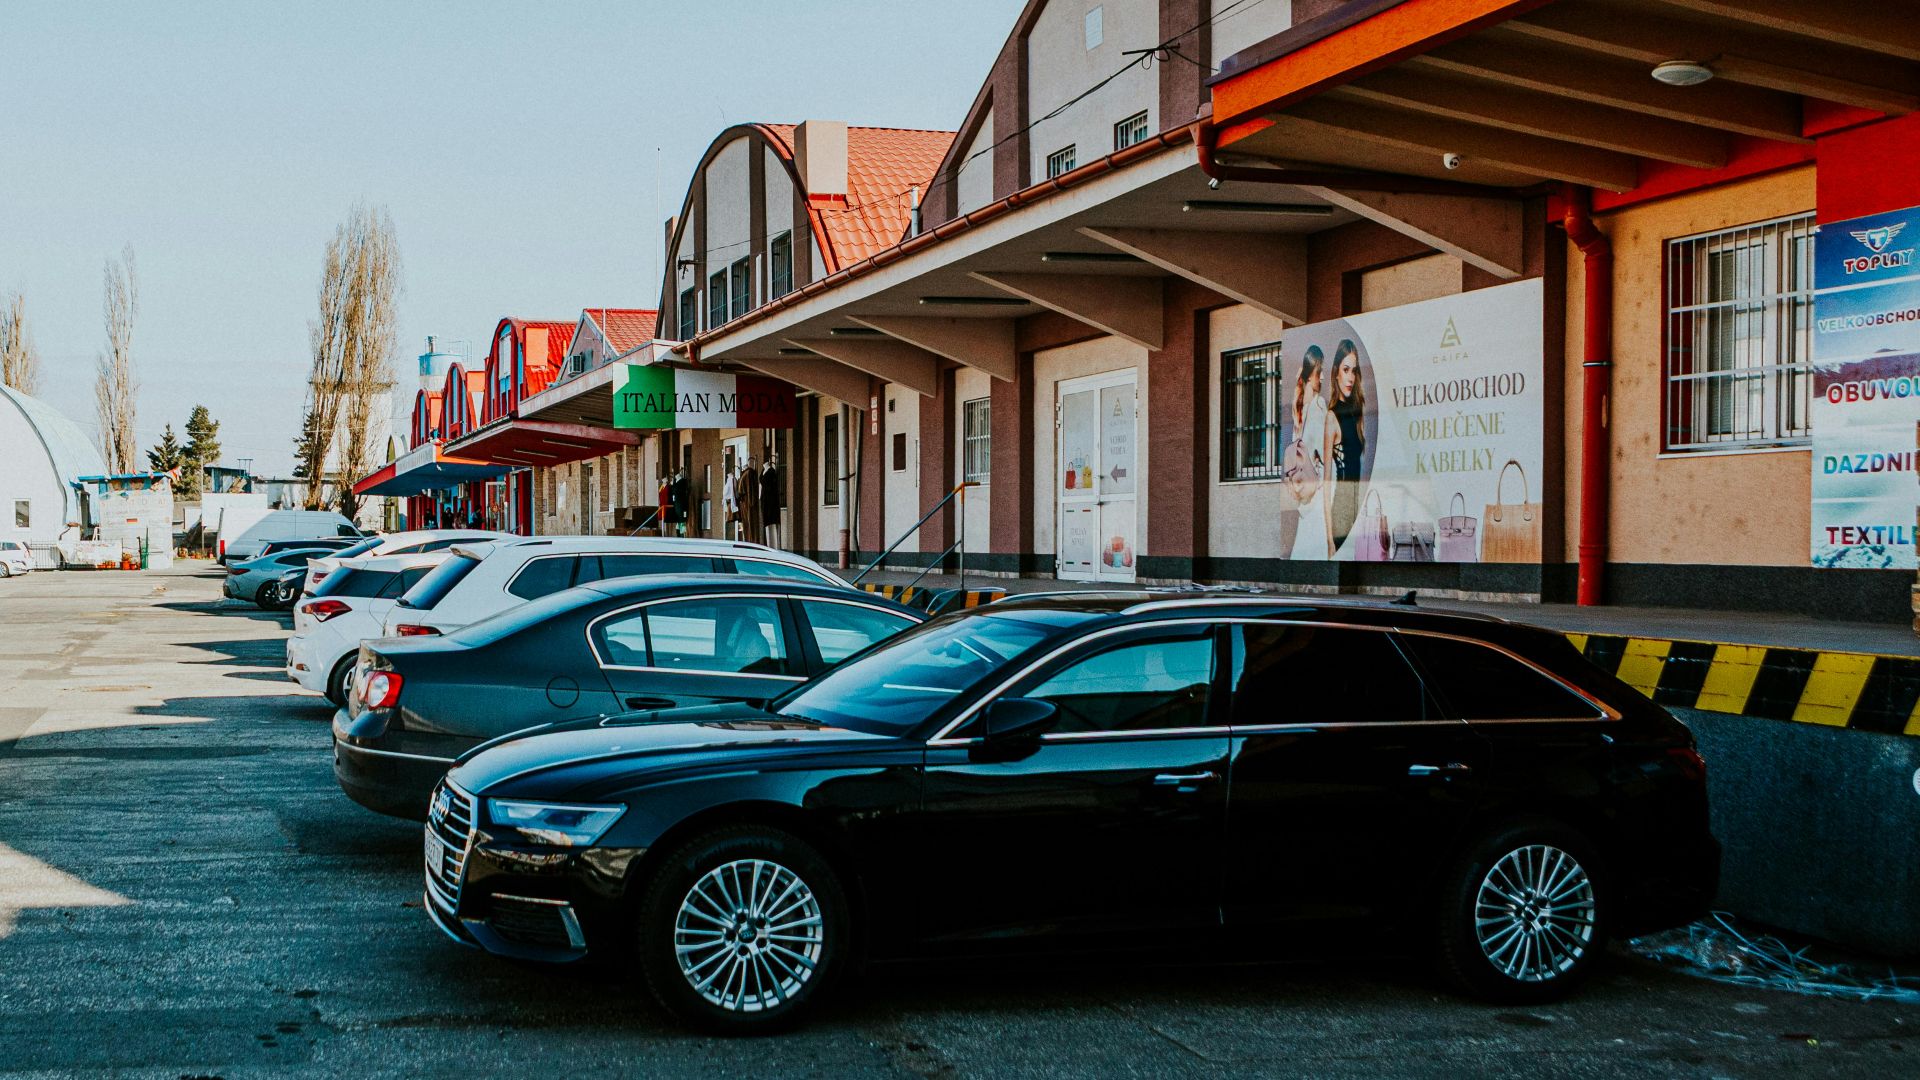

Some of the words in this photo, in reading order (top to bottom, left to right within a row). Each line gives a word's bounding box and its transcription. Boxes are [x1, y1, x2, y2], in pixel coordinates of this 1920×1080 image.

[1844, 249, 1914, 275] TOPLAY
[622, 392, 711, 413] ITALIAN
[718, 392, 788, 414] MODA
[1408, 410, 1506, 441] OBLEČENIE
[1415, 447, 1496, 474] KABELKY
[1823, 452, 1917, 475] DAZDNI
